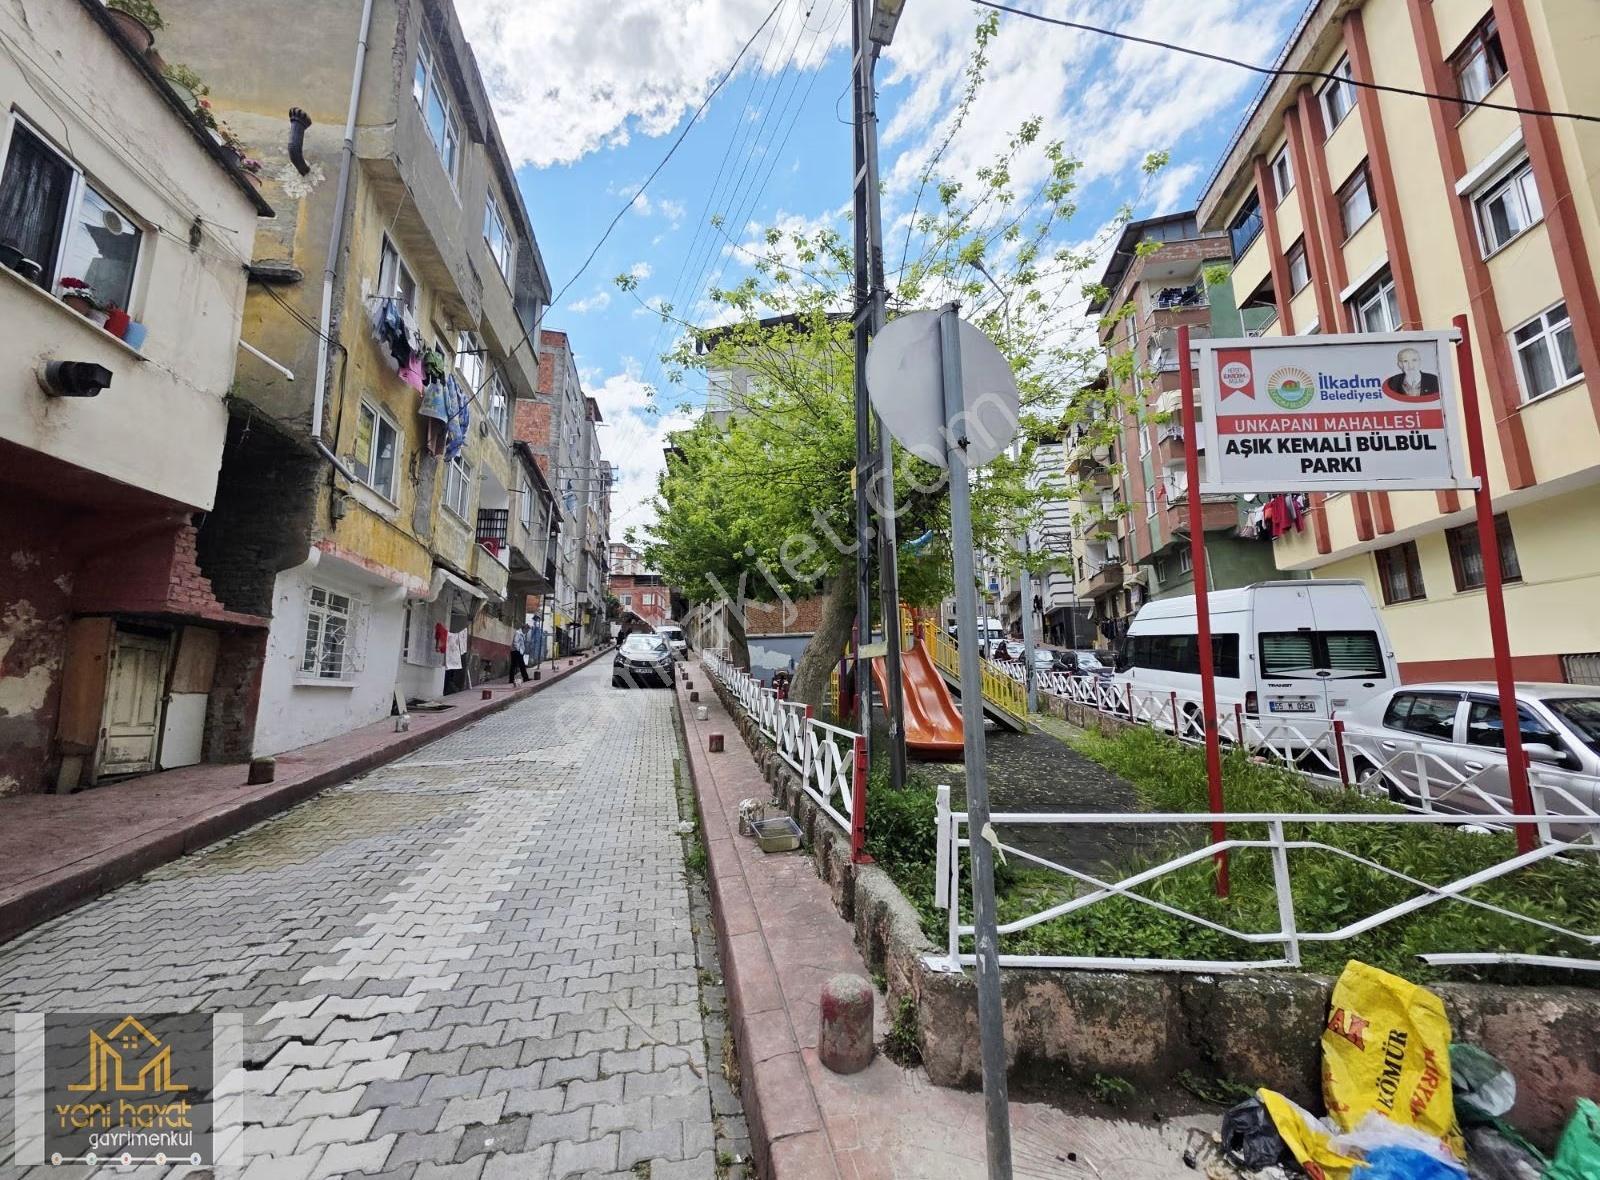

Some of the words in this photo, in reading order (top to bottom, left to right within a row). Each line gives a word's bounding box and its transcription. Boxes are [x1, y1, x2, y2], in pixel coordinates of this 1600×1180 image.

[1319, 372, 1381, 389] İlkadım
[1319, 389, 1383, 402] Belediyesi
[1235, 416, 1318, 433] UNKAPANI
[1324, 411, 1421, 430] MAHALLESİ
[1225, 437, 1274, 458] AŞIK
[1278, 433, 1352, 453] KEMALİ
[1356, 433, 1436, 452] BÜLBÜL
[1300, 456, 1362, 473] PARKI
[1376, 1028, 1408, 1111] KÖMÜR
